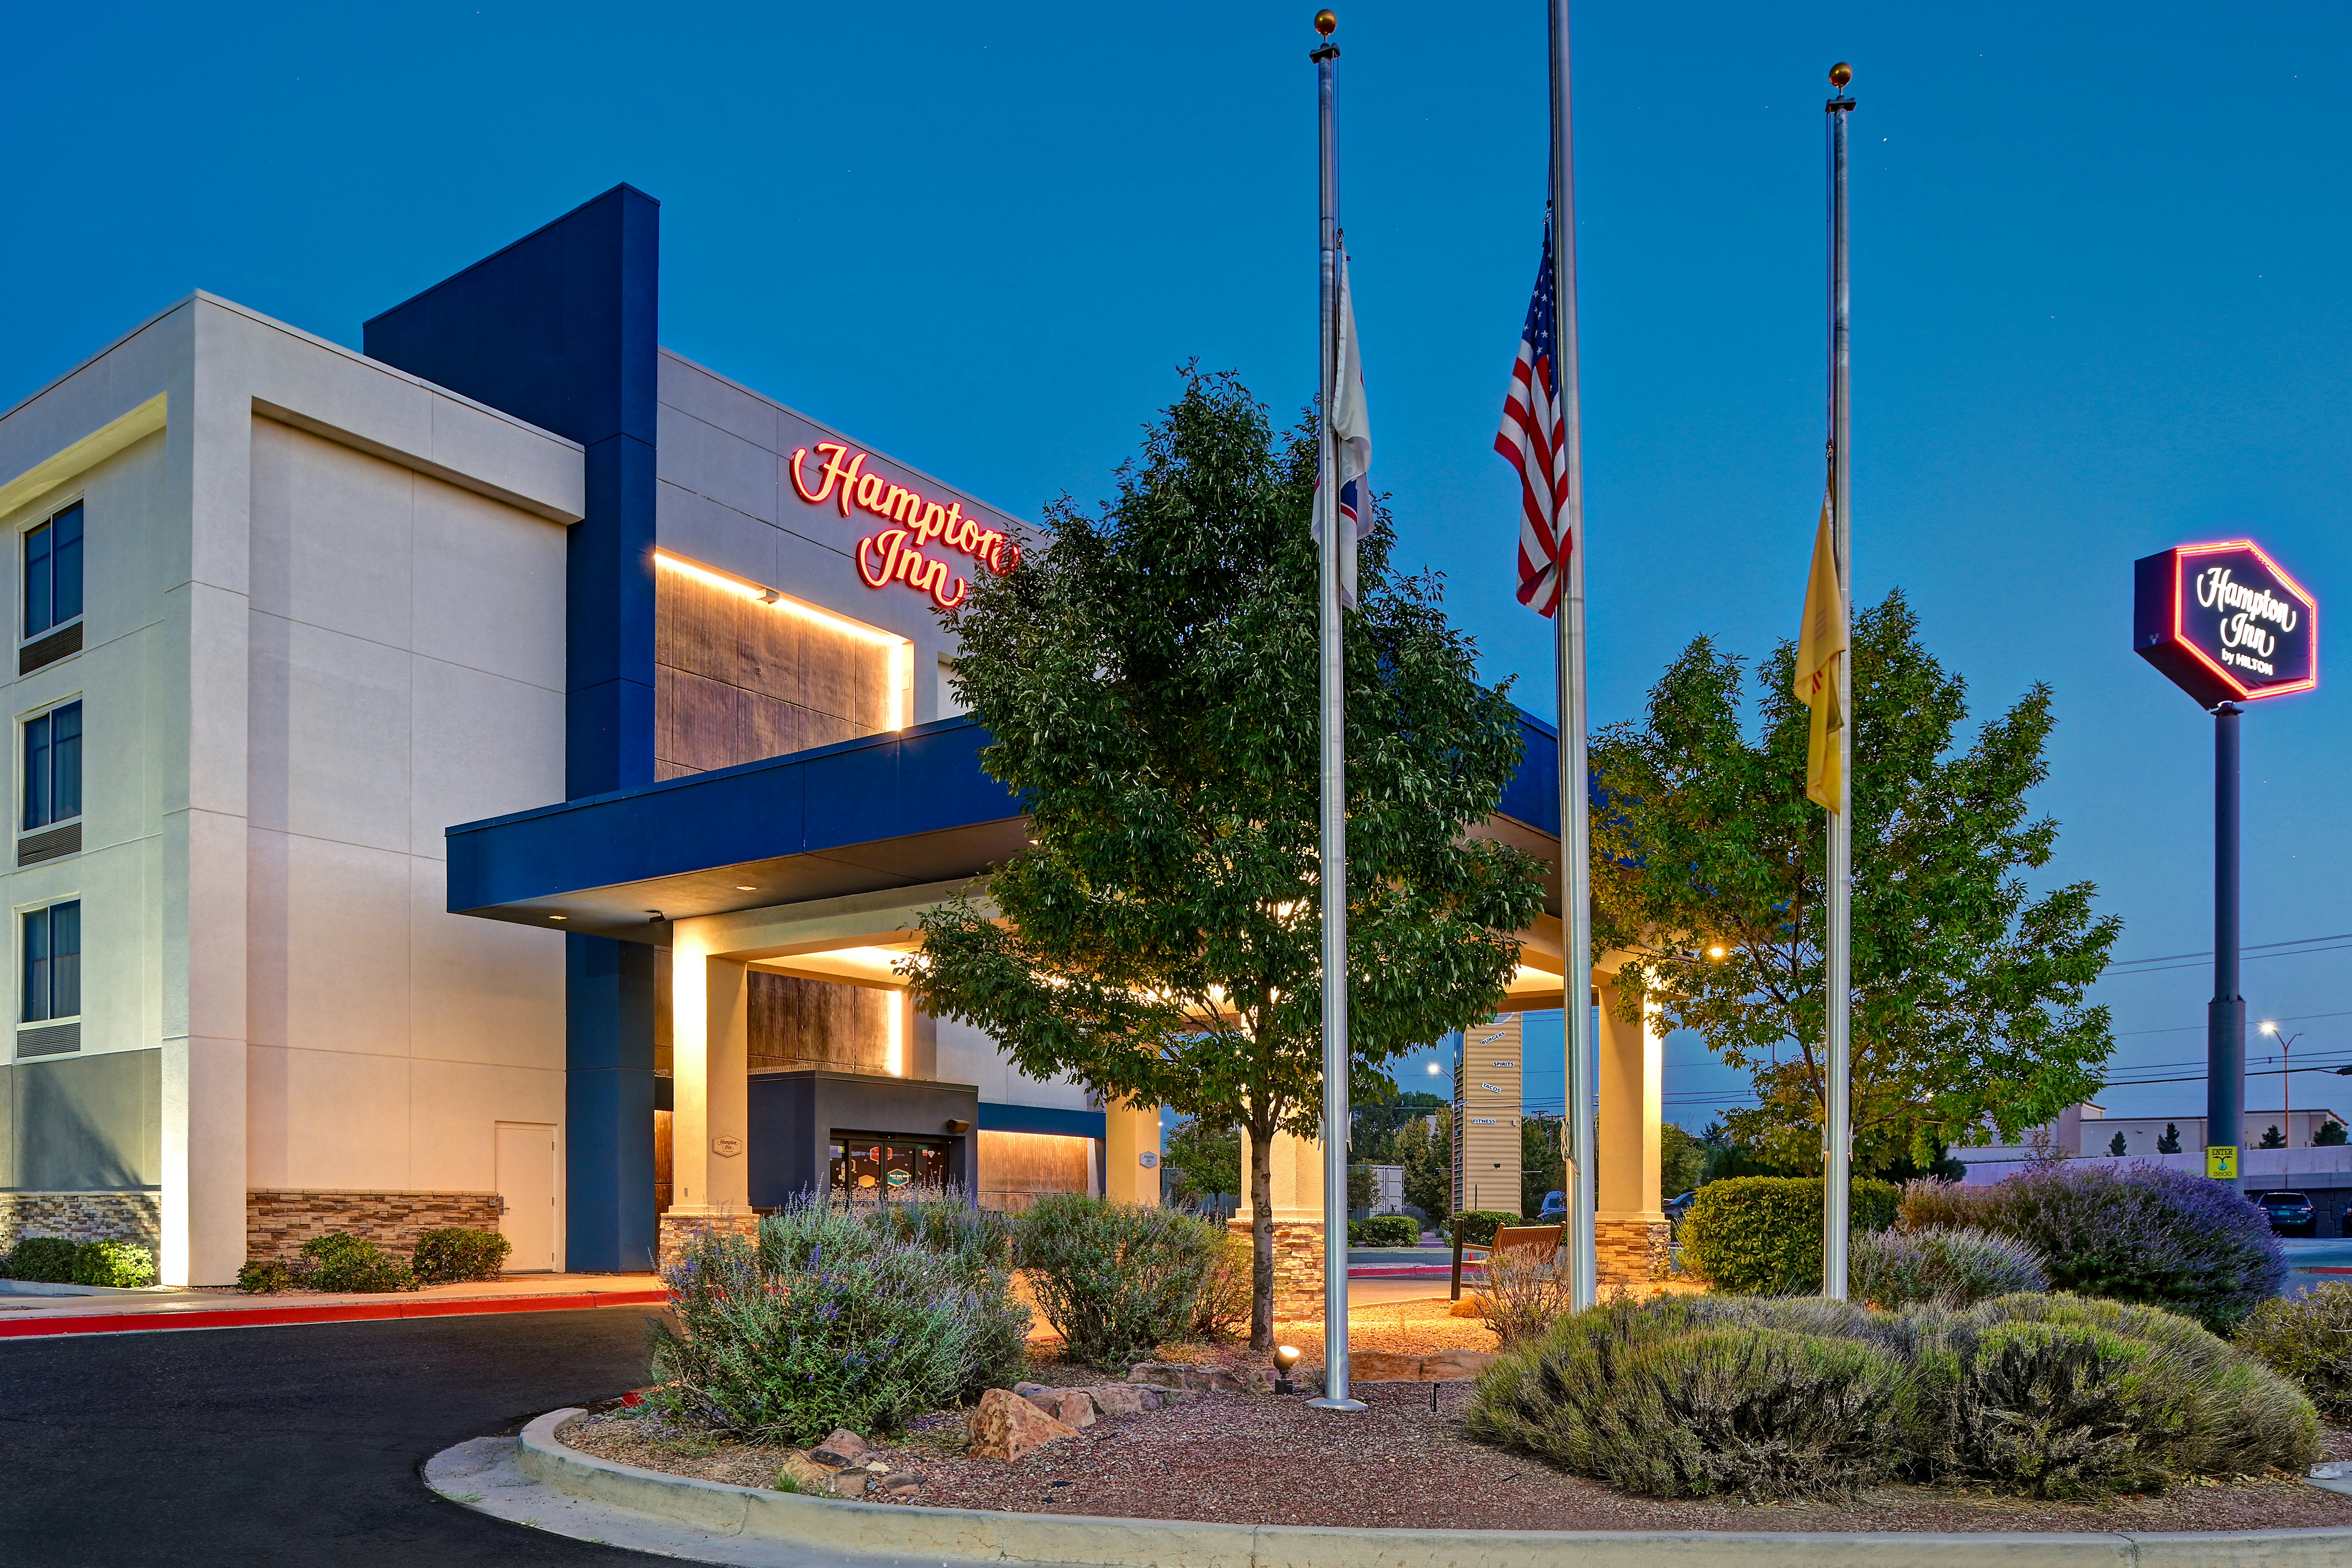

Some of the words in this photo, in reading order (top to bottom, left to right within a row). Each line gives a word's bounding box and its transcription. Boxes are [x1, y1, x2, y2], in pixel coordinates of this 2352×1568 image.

[789, 442, 1019, 575] Hampton
[855, 530, 966, 608] Inn
[2197, 568, 2296, 632] Hampton
[2220, 613, 2274, 657] Inn
[2221, 648, 2234, 665] by
[2236, 653, 2273, 676] HILTON
[1481, 1032, 1505, 1045] BURGERS
[1483, 1083, 1501, 1092] TACOS
